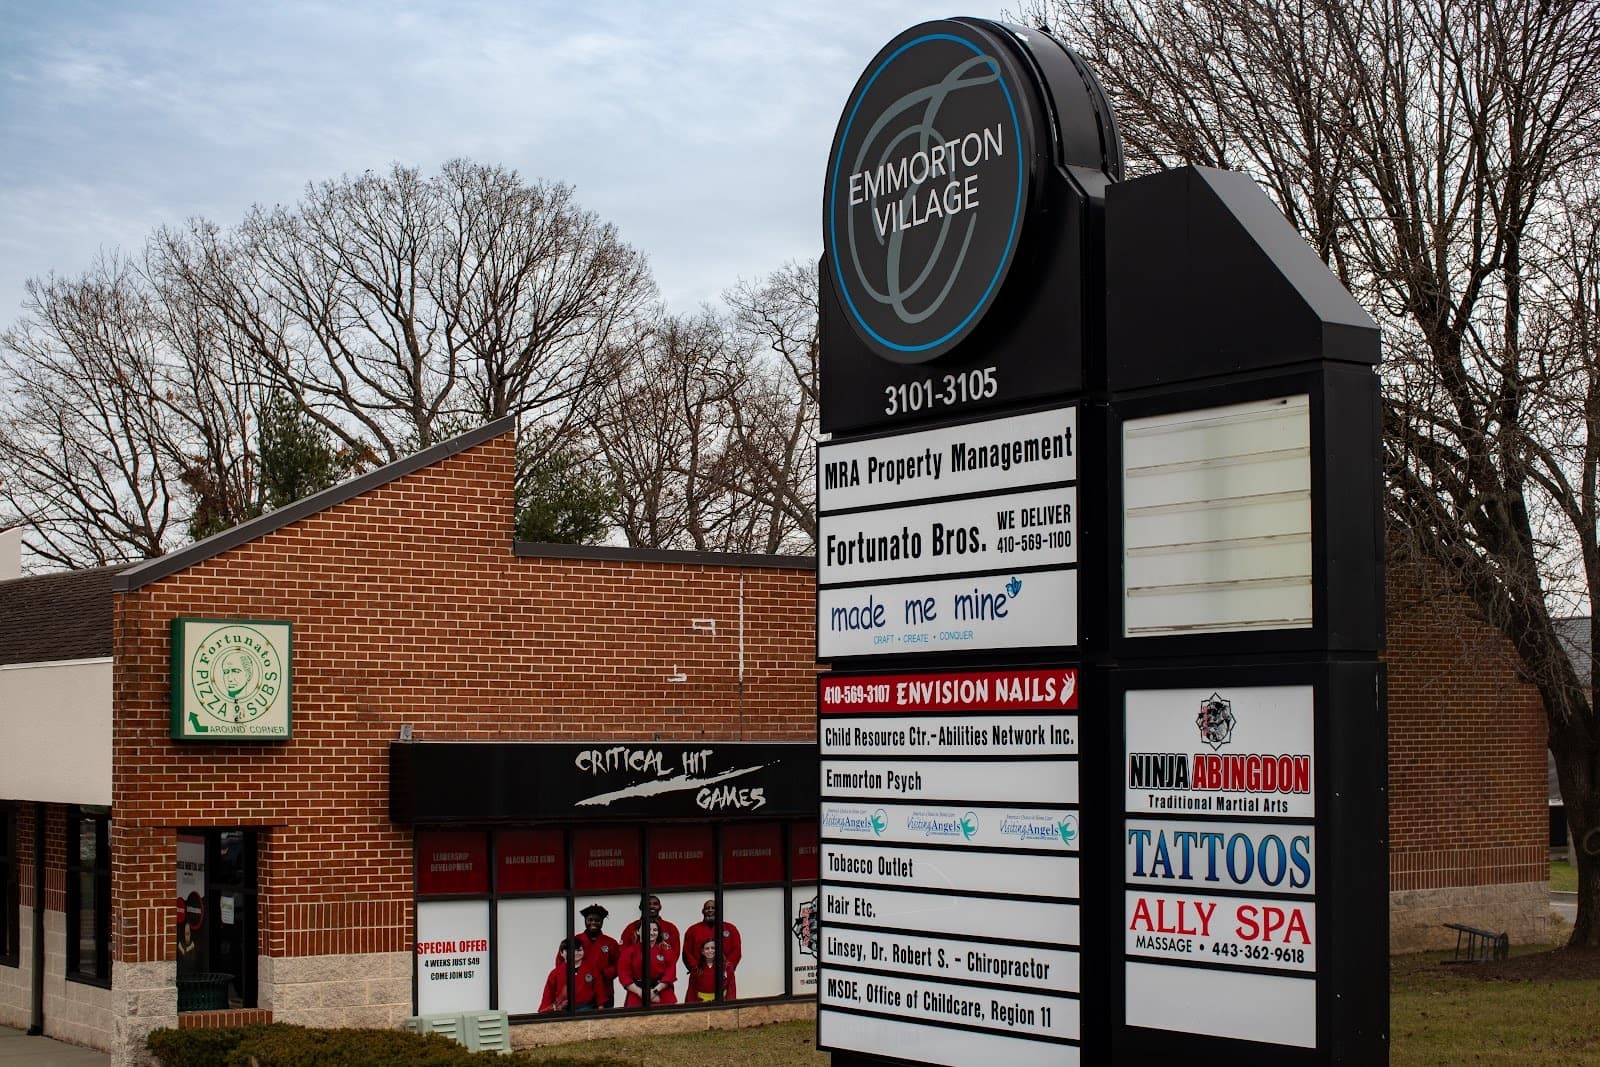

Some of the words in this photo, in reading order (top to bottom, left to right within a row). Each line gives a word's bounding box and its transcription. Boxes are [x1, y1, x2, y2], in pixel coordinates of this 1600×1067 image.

[849, 124, 1003, 206] EMMORTON
[874, 174, 979, 236] VILLAGE
[884, 367, 998, 415] 3101-3105
[825, 460, 860, 490] MRA
[868, 449, 942, 484] Property
[951, 427, 1073, 472] Management
[997, 511, 1015, 530] WE
[1021, 504, 1071, 528] DELIVER
[827, 527, 922, 566] Fortunato
[933, 523, 987, 556] Bros.
[997, 531, 1071, 553] 410-569-1100
[831, 595, 886, 632] made
[906, 598, 936, 625] me
[955, 588, 1009, 621] mine
[200, 634, 271, 667] Fortunato
[874, 635, 894, 645] CRAFT
[904, 634, 929, 643] CREATE
[940, 631, 974, 640] CONQUER
[196, 670, 227, 716] PIZZA
[247, 672, 277, 716] SUBS
[824, 685, 890, 704] 410-569-3107
[897, 679, 988, 705] ENVISION
[996, 678, 1056, 703] NAILS
[825, 727, 851, 747] Child
[855, 728, 905, 746] Resource
[992, 725, 1045, 745] Network
[1050, 724, 1074, 745] Inc.
[575, 747, 674, 776] CRITICAL
[682, 749, 714, 774] HIT
[1129, 752, 1190, 789] NINJA
[1192, 754, 1310, 794] ABINGDON
[827, 769, 882, 789] Emmorton
[888, 771, 922, 792] Psych
[696, 786, 767, 811] GAMES
[1148, 794, 1211, 810] Traditional
[1217, 797, 1258, 812] Martial
[1263, 798, 1288, 813] Arts
[845, 817, 871, 829] Angels
[931, 819, 961, 832] Angels
[1027, 823, 1060, 836] Angels
[828, 853, 873, 874] Tobacco
[878, 856, 913, 877] Outlet
[1128, 829, 1311, 888] TATTOOS
[828, 894, 850, 915] Hair
[855, 898, 876, 918] Etc.
[1130, 898, 1217, 936] ALLY
[1235, 904, 1312, 945] SPA
[417, 942, 456, 954] SPECIAL
[460, 940, 487, 952] OFFER
[828, 937, 866, 961] Linsey,
[872, 942, 887, 961] Dr.
[893, 944, 932, 967] Robert
[938, 949, 949, 969] S.
[968, 951, 1050, 980] Chiropractor
[1136, 936, 1192, 953] MASSAGE
[1212, 942, 1304, 964] 443-362-9618
[430, 959, 450, 967] WEEKS
[431, 972, 448, 980] COME
[450, 971, 462, 979] JOIN
[828, 979, 861, 1004] MSDE,
[867, 984, 901, 1006] Office
[907, 990, 918, 1008] of
[923, 991, 985, 1021] Childcare,
[992, 1000, 1035, 1027] Region
[1041, 1007, 1051, 1028] 11
